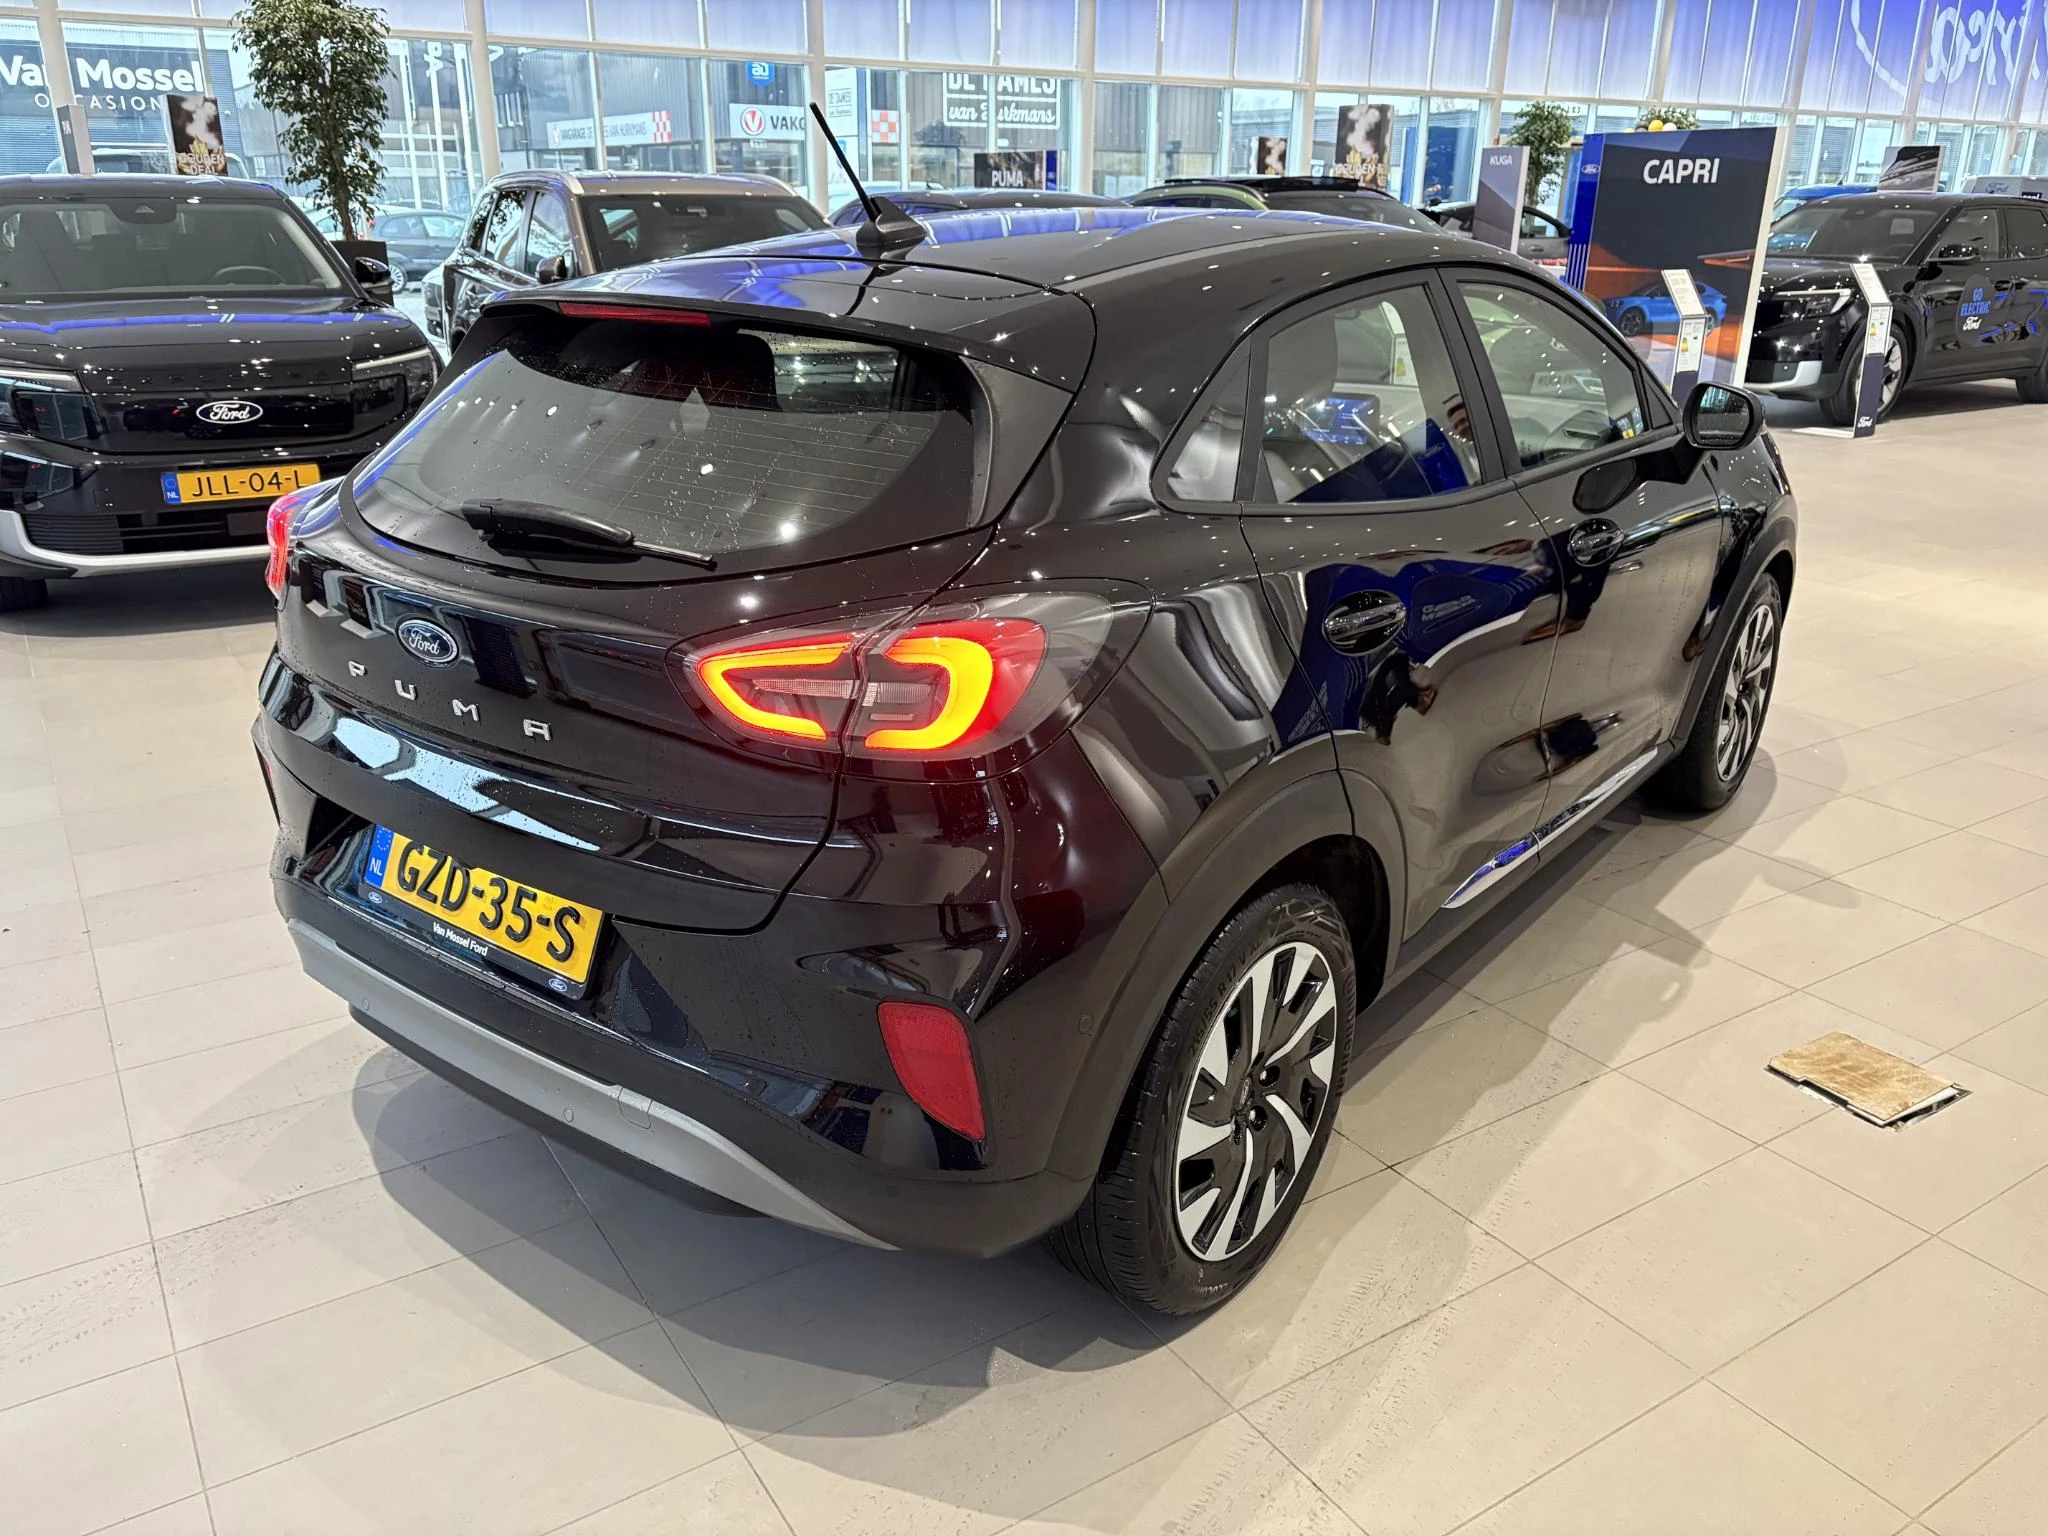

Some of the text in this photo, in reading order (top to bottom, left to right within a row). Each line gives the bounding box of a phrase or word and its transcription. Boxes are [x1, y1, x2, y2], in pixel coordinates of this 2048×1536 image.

[76, 57, 205, 93] Mossel
[983, 75, 1056, 95] AMES
[948, 105, 978, 121] van
[180, 152, 225, 166] GOUDEN
[1489, 154, 1513, 166] KUGA
[190, 163, 219, 175] DEAL
[1335, 163, 1376, 176] GOUDEN
[1643, 157, 1720, 184] CAPRI
[991, 170, 1024, 187] PUMA
[1973, 288, 1984, 300] GO
[1961, 301, 1991, 316] ELECTRIC
[1962, 317, 1982, 330] Ford
[209, 403, 250, 420] Ford
[1858, 416, 1873, 427] Ford
[167, 470, 308, 499] NL JLL-04-L
[408, 627, 441, 656] Ford
[348, 660, 552, 741] PUMA
[369, 840, 581, 963] NL GZD-35-S
[433, 921, 488, 956] Van Mossel Ford
